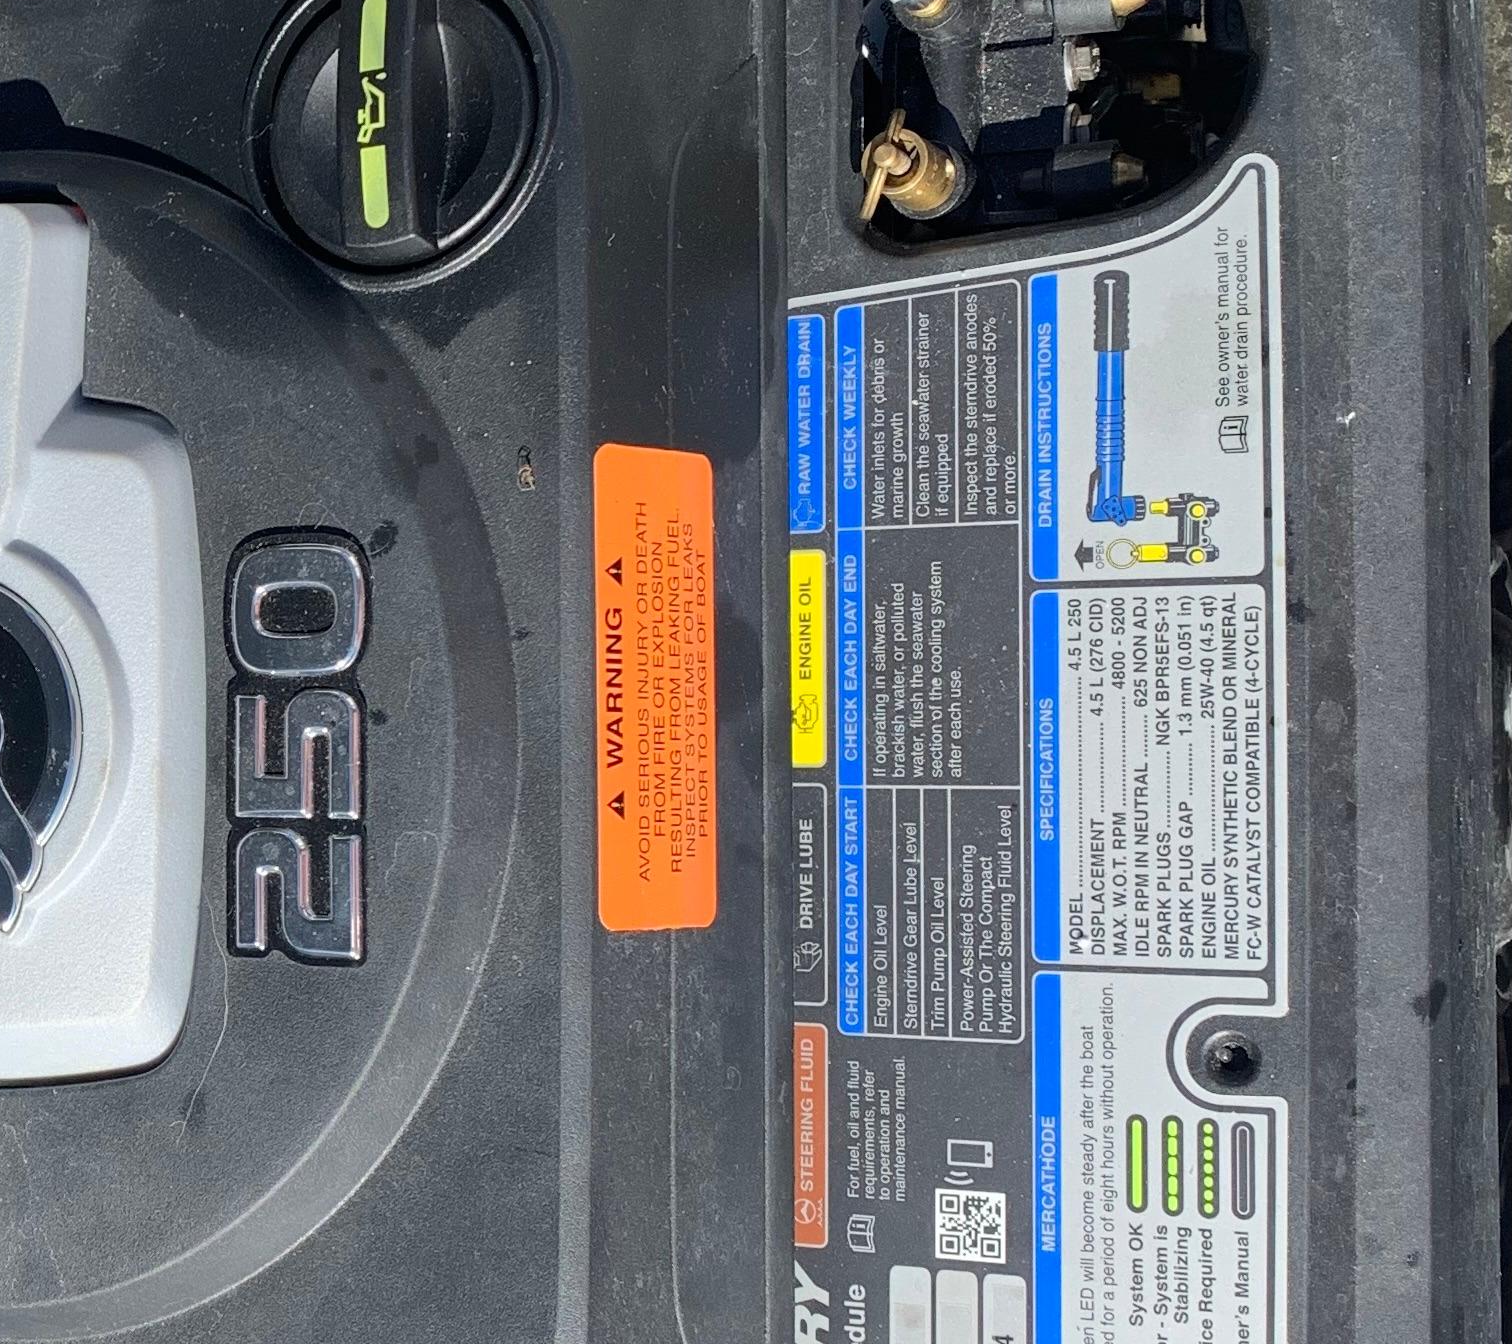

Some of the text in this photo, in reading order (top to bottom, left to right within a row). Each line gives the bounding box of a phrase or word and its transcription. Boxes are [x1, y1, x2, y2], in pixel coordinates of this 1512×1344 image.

[798, 319, 811, 495] RAW WATER DRAIN
[843, 346, 857, 489] CHECK WEEKLY
[871, 339, 887, 519] Water inlets for debris or
[890, 413, 906, 518] marine growth
[1038, 323, 1052, 527] DRAIN INSTRUCTIONS
[605, 608, 623, 768] WARNING
[636, 503, 650, 882] AVOID SERIOUS INJURY OR DEATH
[652, 542, 665, 836] FROM FIRE OR EXPLOSION
[668, 577, 680, 669] LEAKING
[683, 524, 696, 857] INSPECT SYSTEMS FOR LEAKS
[696, 550, 708, 837] PRIOR TO USAGE OF BOAT
[799, 578, 811, 679] ENGINE OIL
[844, 555, 857, 761] CHECK EACH DAY END
[228, 532, 368, 961] 250
[669, 678, 681, 740] FROM
[1039, 698, 1054, 840] SPECIFICATIONS
[1068, 599, 1084, 954] MODEL 4.5 L 250
[1089, 598, 1106, 954] DISPLACEMENT 4.5 L (276 CID)
[1155, 597, 1171, 957] SPARK PLUGS NGK BPR5EFS-13
[1199, 596, 1217, 958] ENGINE OIL 25W-40 (4.5 qt)
[1222, 592, 1239, 959] MERCURY SYNTHETIC BLEND OR MINERAL
[1245, 606, 1263, 960] FC-W CATALYST COMPATIBLE (4-CYCLE)
[670, 750, 682, 872] RESULTING
[799, 818, 813, 928] DRIVE LUBE
[845, 797, 858, 1025] CHECK EACH DAY START
[874, 905, 891, 1027] Engine Oil Level
[903, 823, 920, 1028] Sterndrive Gear Lube Level
[931, 878, 947, 1030] Trim Pump Oil Level
[800, 1039, 813, 1191] STEERING FLUID
[1041, 1117, 1055, 1251] MERCATHODE
[1129, 1223, 1147, 1326] System OK
[1174, 1227, 1192, 1323] Stabilizing
[1198, 1228, 1216, 1312] Required
[1234, 1231, 1249, 1297] Manual
